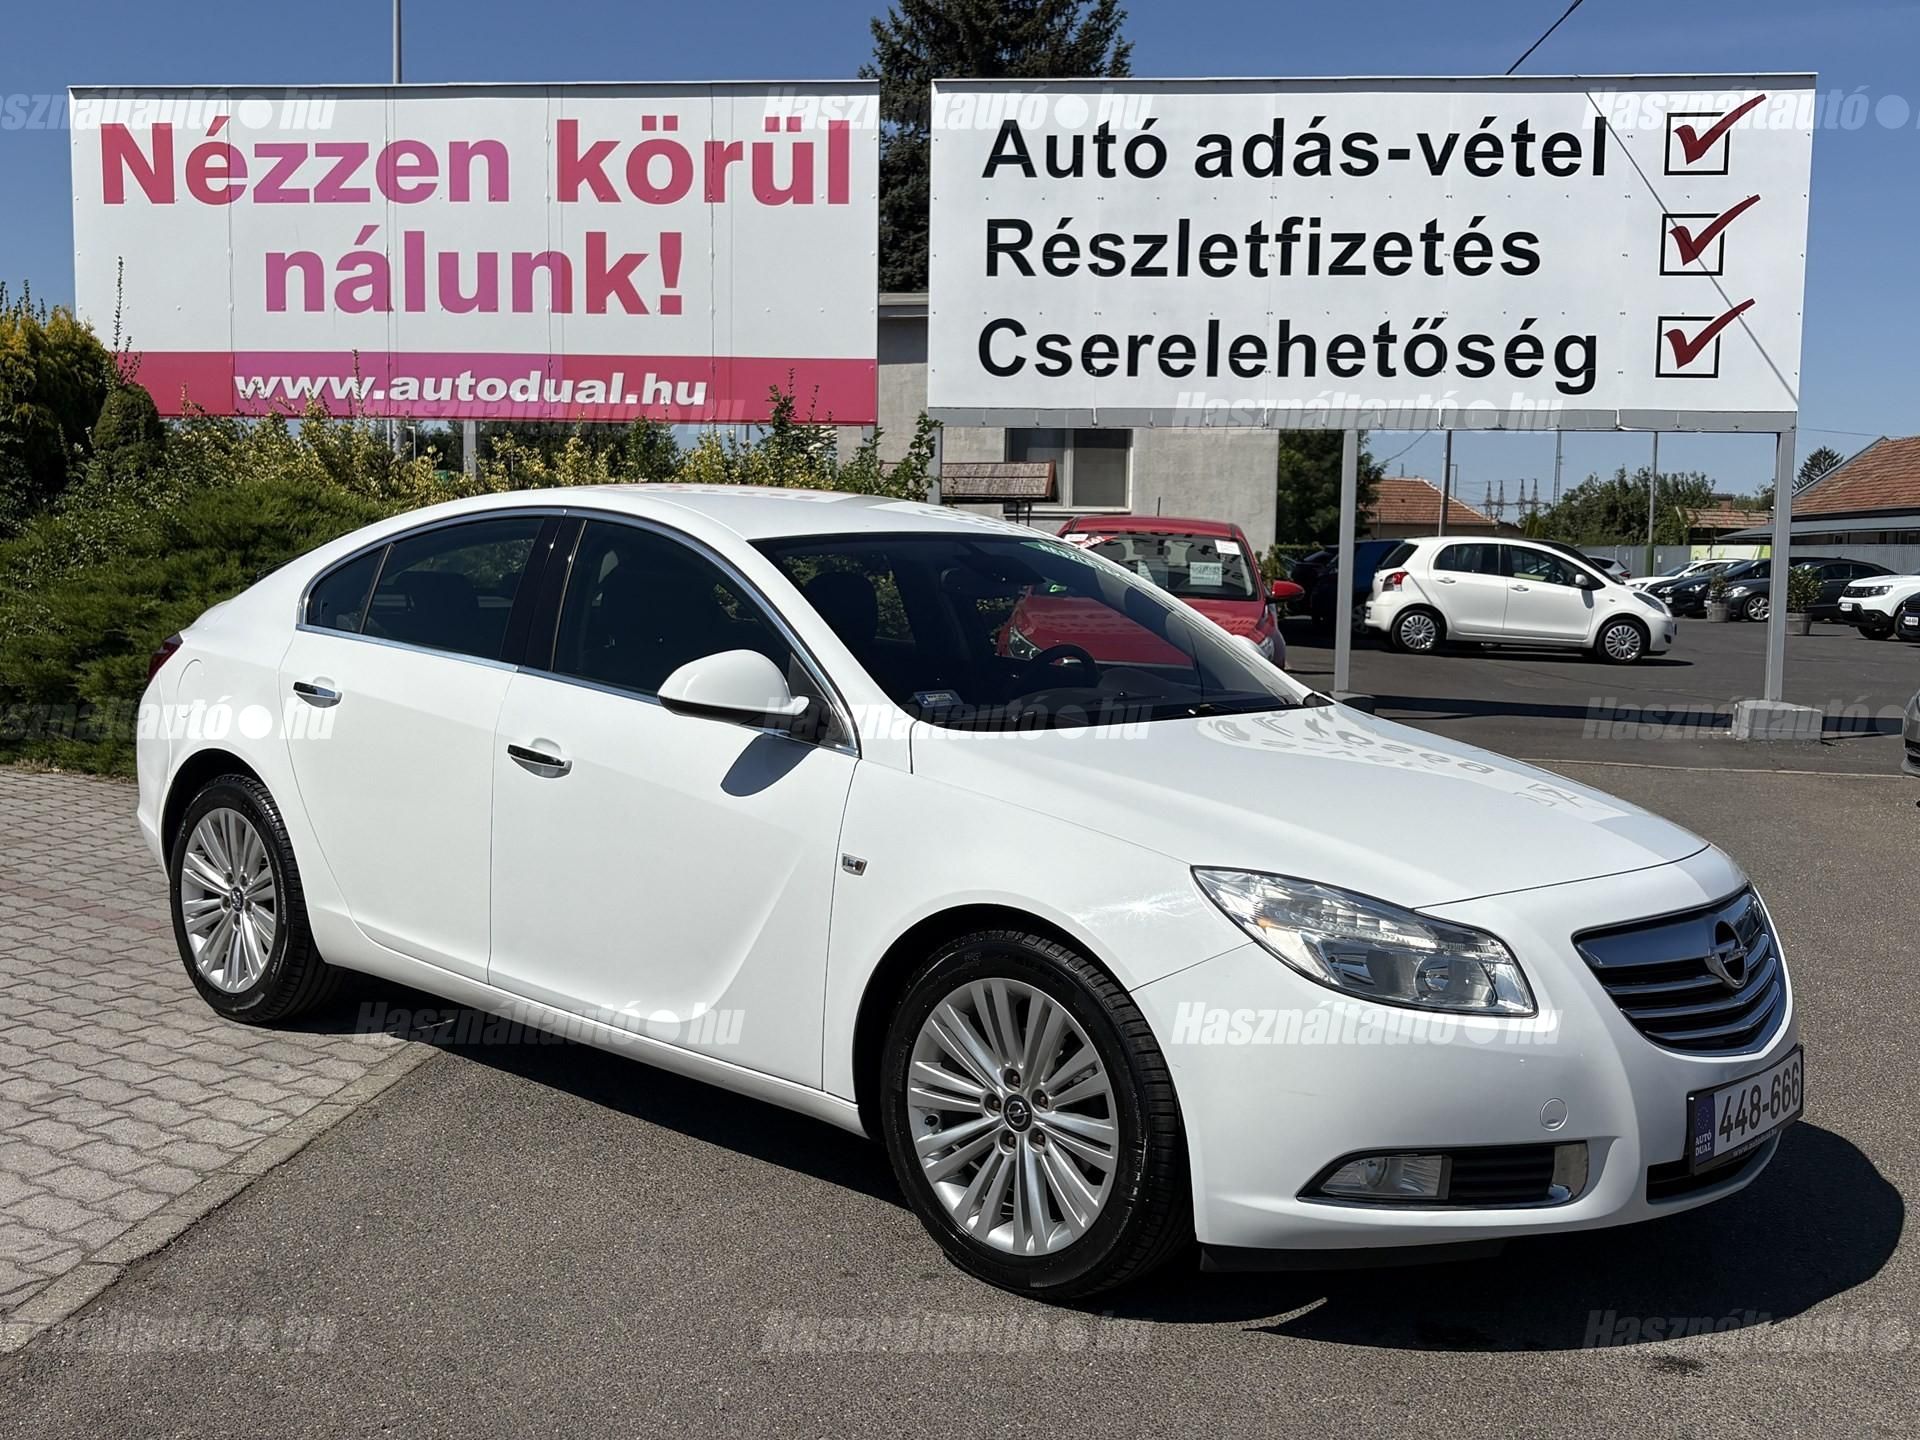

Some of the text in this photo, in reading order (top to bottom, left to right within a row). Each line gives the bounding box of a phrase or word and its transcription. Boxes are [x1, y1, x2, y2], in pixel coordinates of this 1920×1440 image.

[102, 116, 849, 204] Nézzen körül
[983, 116, 1606, 179] Autó adás-vétel
[267, 226, 682, 315] nálunk!
[986, 216, 1540, 278] Részletfizetés
[234, 370, 707, 406] www.autodual.hu
[978, 317, 1597, 395] Cserelehetőség
[1718, 1061, 1800, 1143] 448-666
